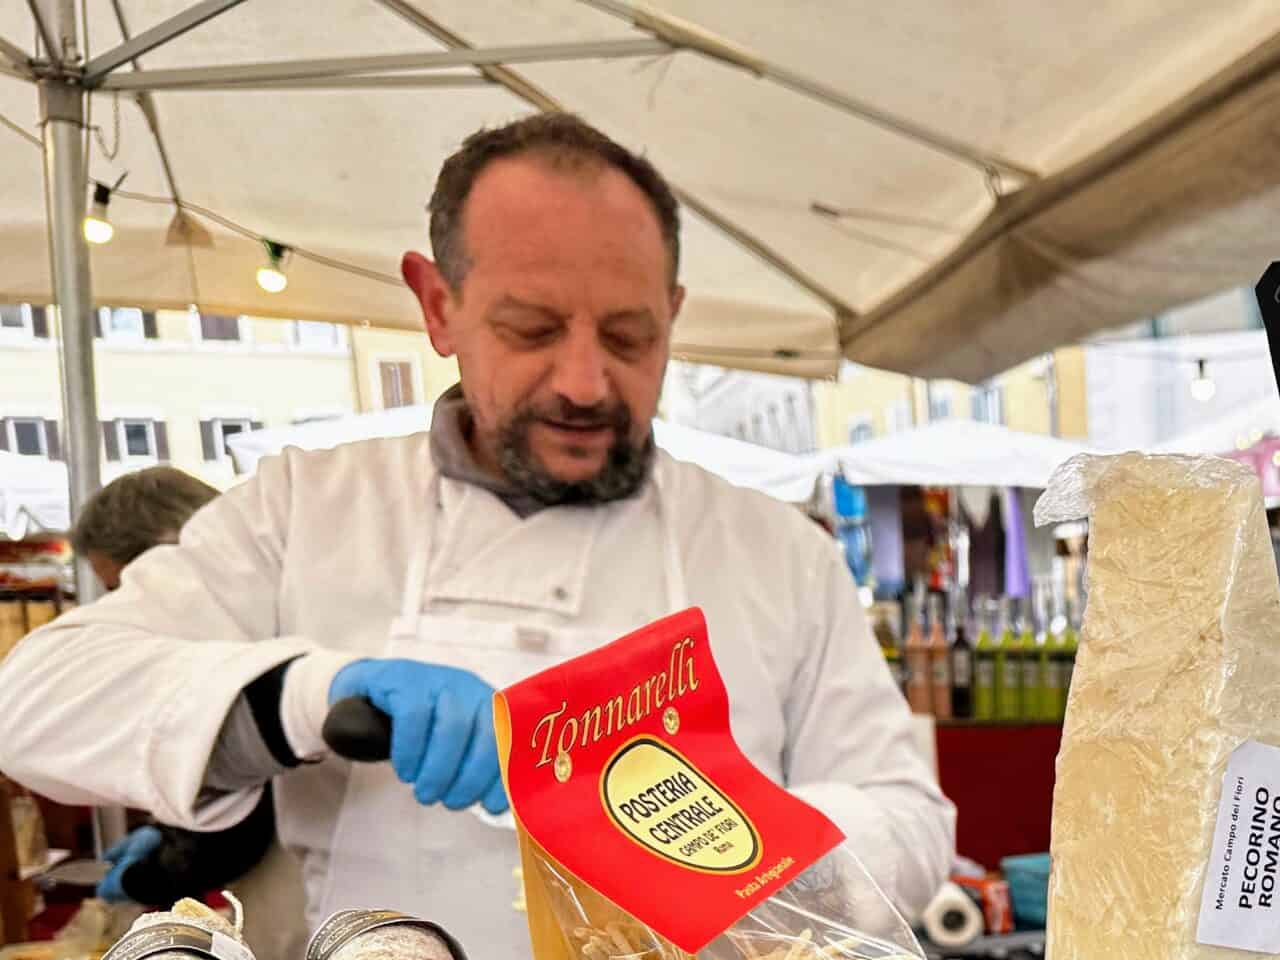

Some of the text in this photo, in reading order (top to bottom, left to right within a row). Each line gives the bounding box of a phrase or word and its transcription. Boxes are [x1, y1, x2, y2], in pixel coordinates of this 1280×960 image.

[532, 637, 700, 768] Tonnarelli
[619, 771, 698, 823] POSTERIA
[649, 795, 723, 844] CENTRALE
[1216, 776, 1244, 910] Mercato Campo dei Fiori
[1238, 787, 1270, 909] PECORINO
